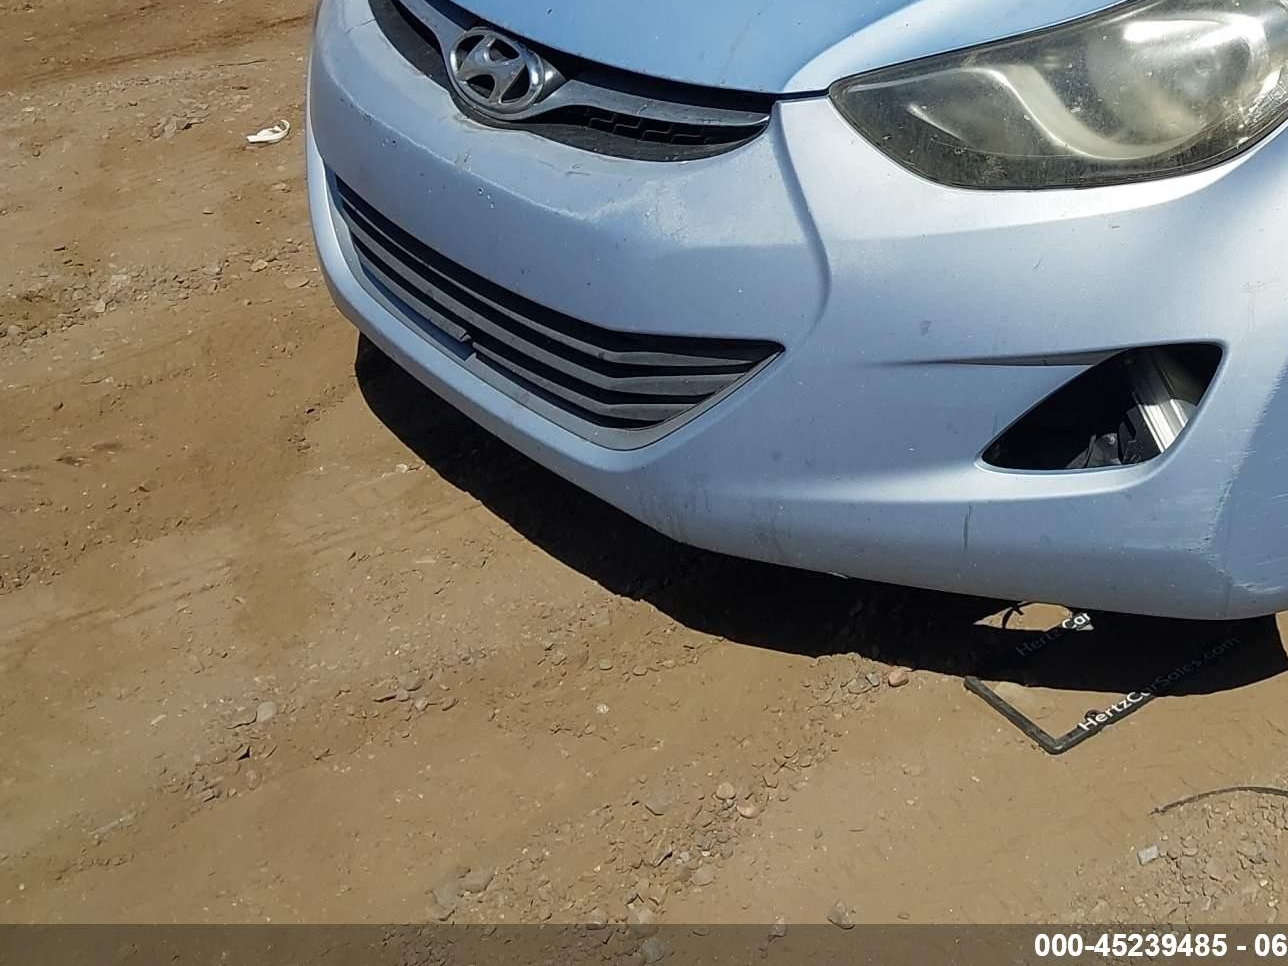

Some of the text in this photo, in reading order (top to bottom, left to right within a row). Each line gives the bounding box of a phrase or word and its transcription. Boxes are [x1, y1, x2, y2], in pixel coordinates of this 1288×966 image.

[1015, 612, 1091, 657] Hertz Car
[1078, 636, 1240, 731] HertzCarSales.com
